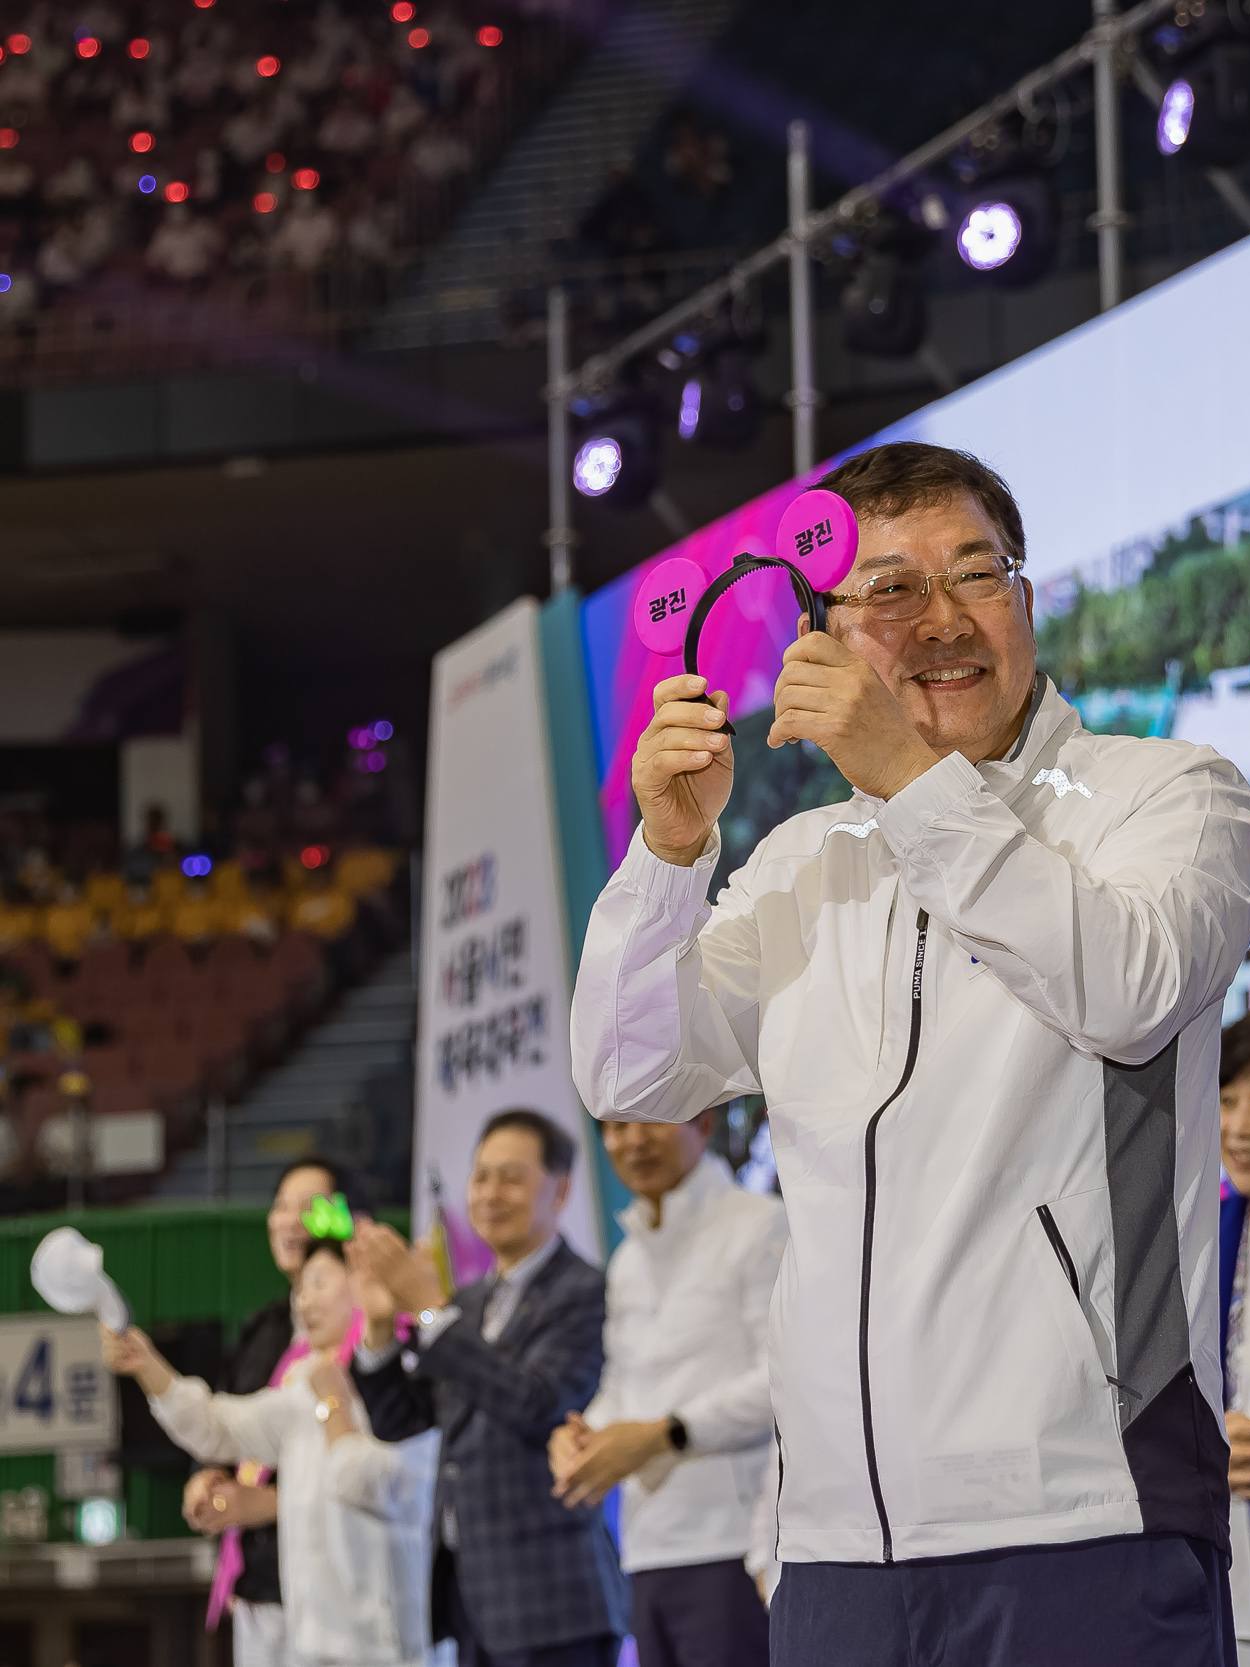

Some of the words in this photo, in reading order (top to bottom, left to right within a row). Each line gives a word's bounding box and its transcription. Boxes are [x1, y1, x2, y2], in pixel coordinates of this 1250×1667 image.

[793, 518, 834, 557] 광진
[648, 587, 688, 623] 광진
[442, 850, 496, 930] 2023
[916, 939, 925, 968] SINCE
[914, 970, 922, 999] PUMA
